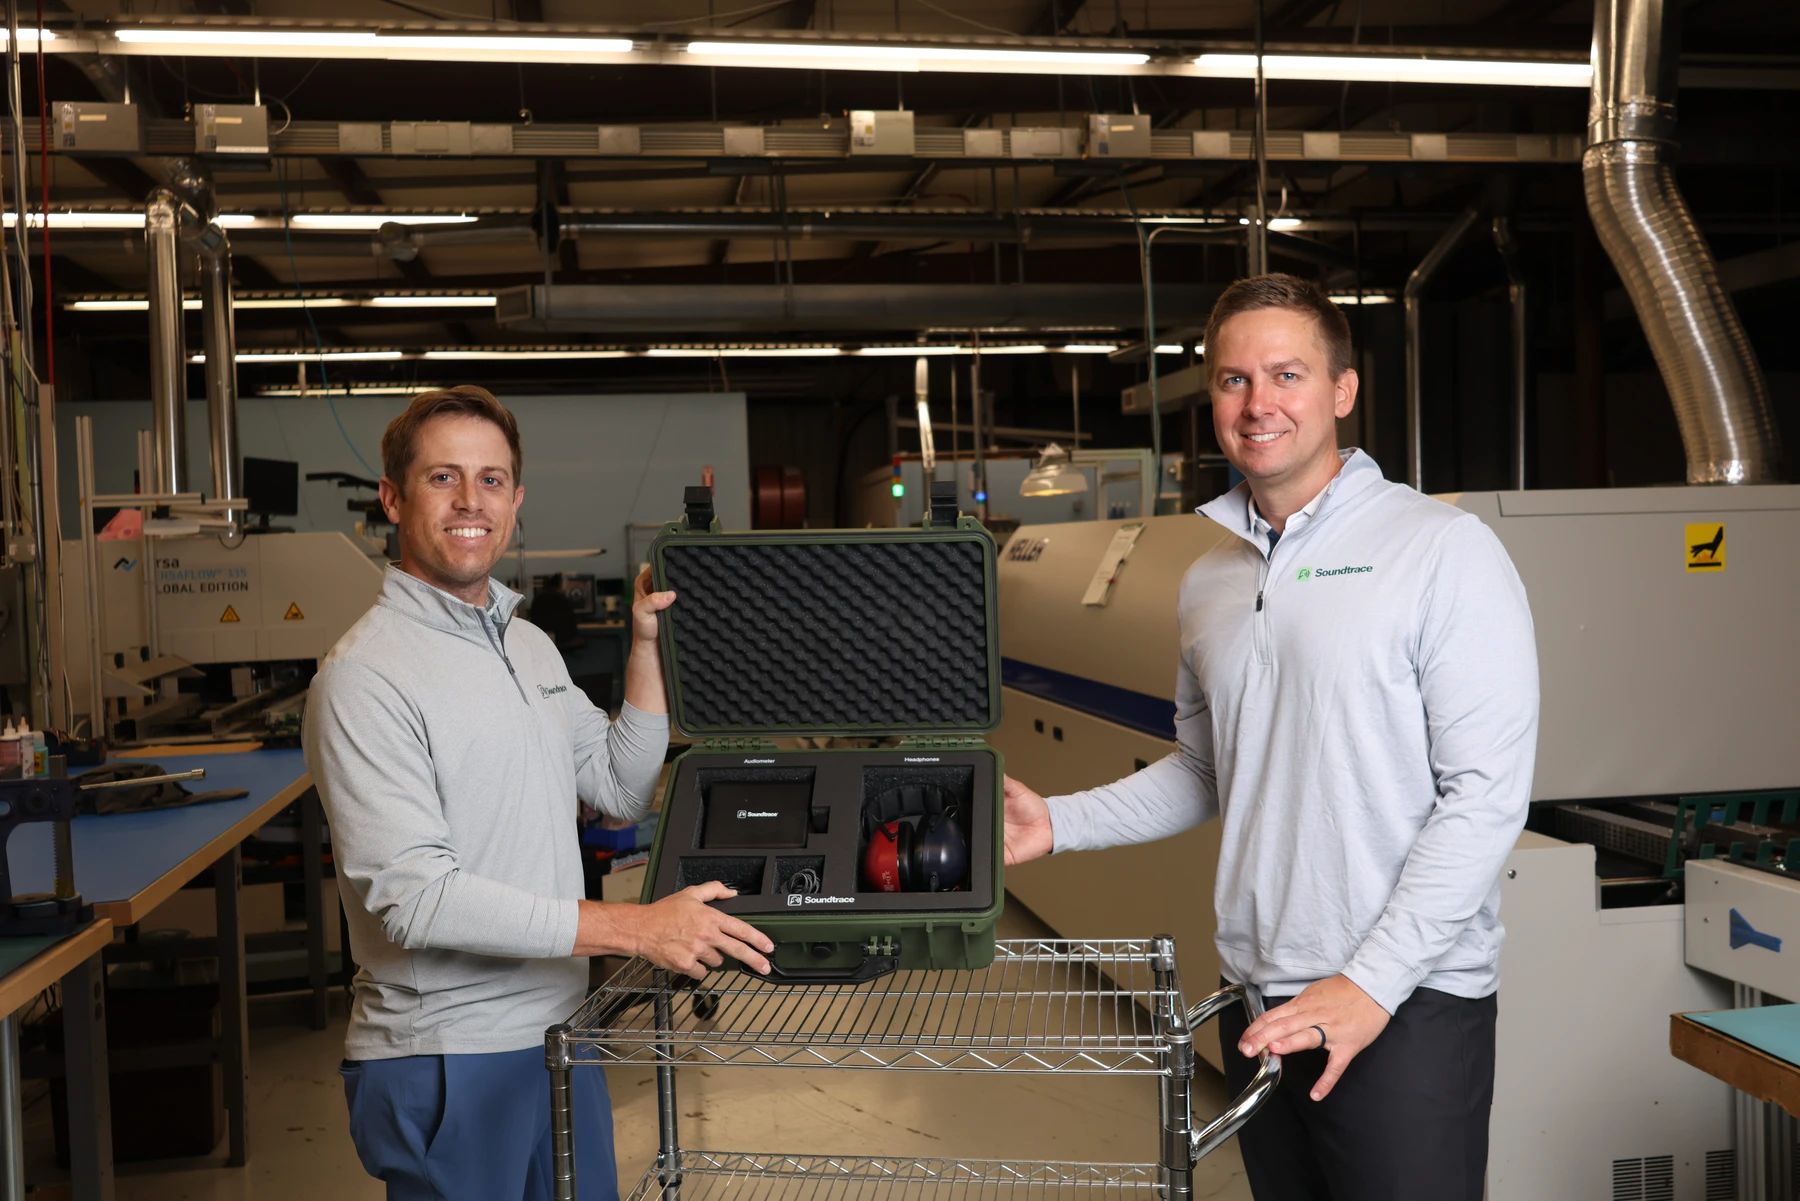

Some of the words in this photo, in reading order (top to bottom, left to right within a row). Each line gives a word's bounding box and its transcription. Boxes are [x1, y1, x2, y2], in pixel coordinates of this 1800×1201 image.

[155, 558, 179, 569] rsa
[1315, 565, 1373, 578] Soundtrace
[155, 583, 196, 595] LOBAL
[200, 581, 249, 593] EDITION
[804, 895, 856, 904] Soundtrace
